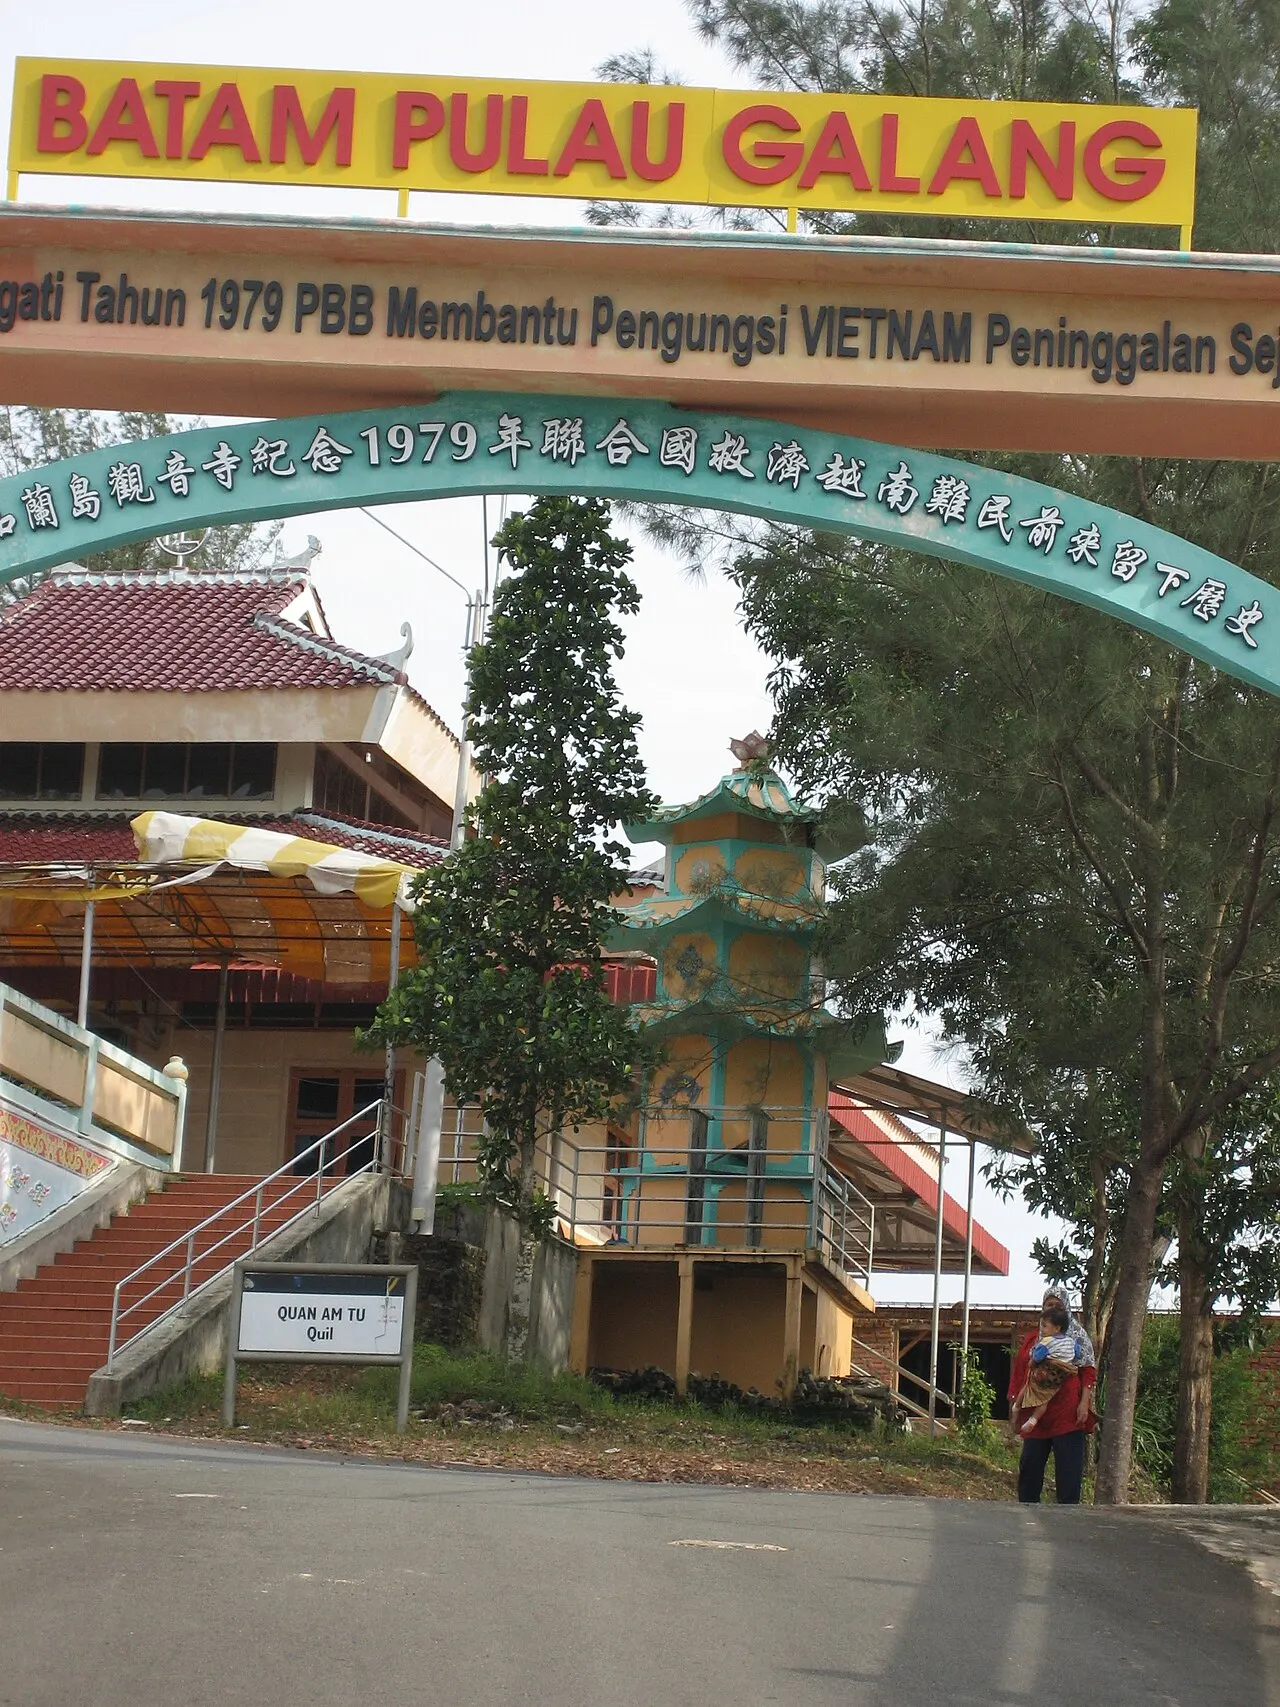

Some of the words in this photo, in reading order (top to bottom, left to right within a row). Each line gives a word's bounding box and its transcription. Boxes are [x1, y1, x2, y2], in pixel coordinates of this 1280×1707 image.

[37, 74, 356, 168] BATAM
[392, 90, 685, 181] PULAU
[722, 104, 1166, 202] GALANG
[0, 270, 64, 333] gati
[76, 271, 187, 327] Tahun
[200, 277, 284, 333] 1979
[294, 282, 375, 336] PBB
[386, 286, 579, 346] Membantu
[590, 294, 788, 367] Pengungsi
[801, 304, 972, 364] VIETNAM
[985, 313, 1217, 385] Peninggalan
[277, 1306, 317, 1322] QUAN
[321, 1307, 343, 1321] AM
[347, 1308, 366, 1322] TU
